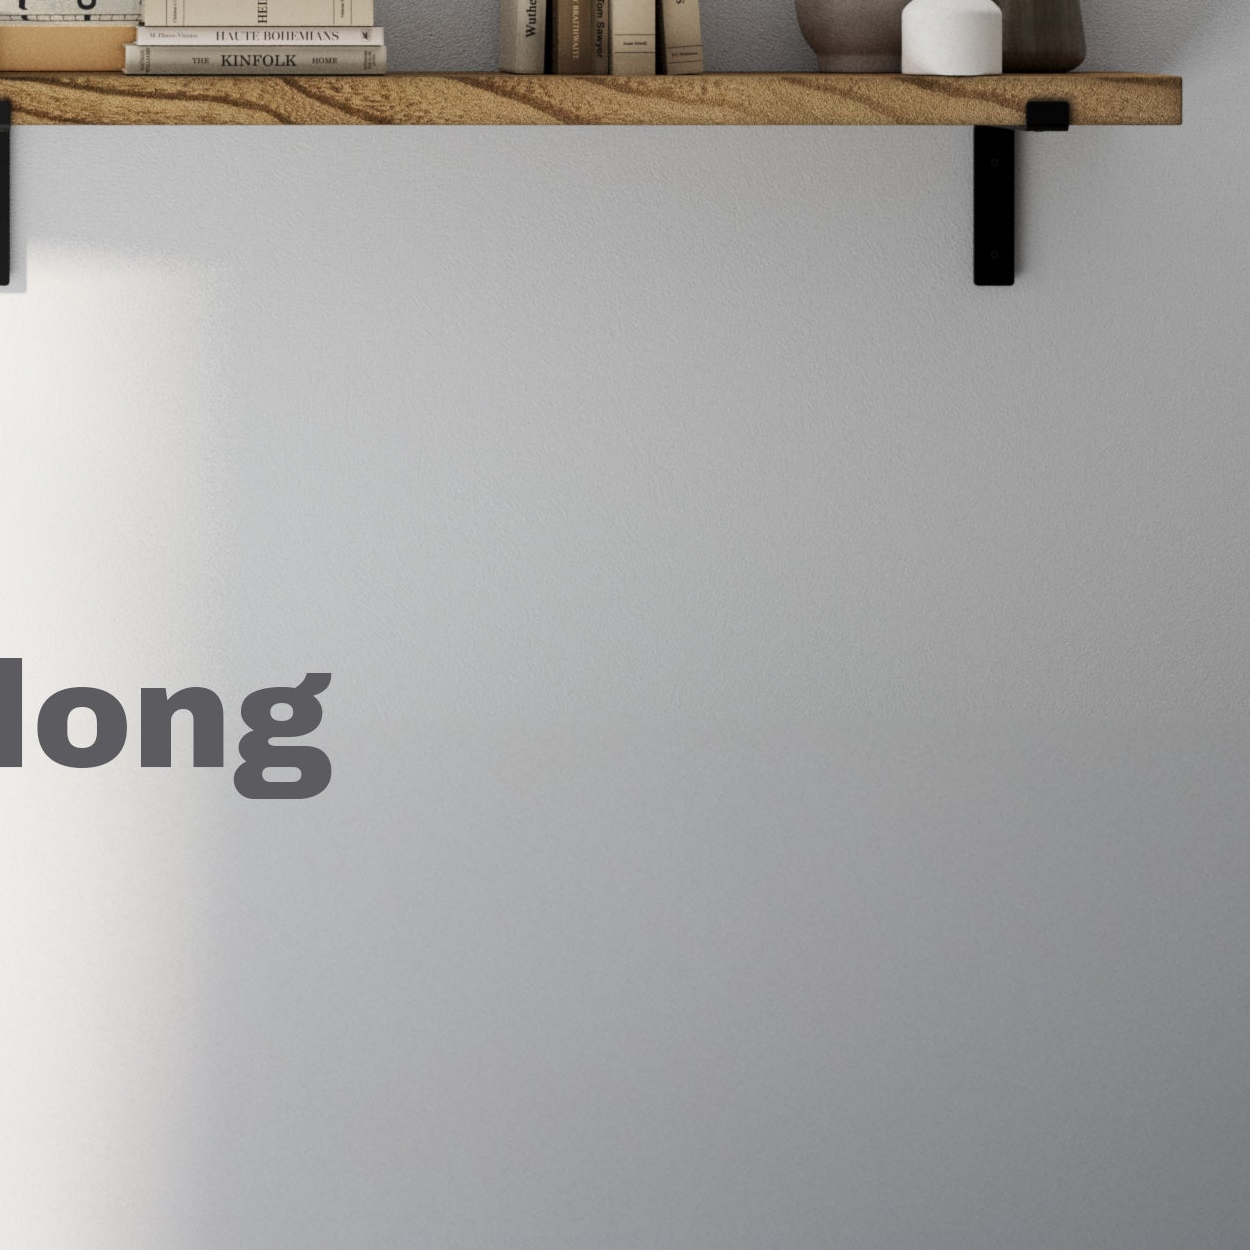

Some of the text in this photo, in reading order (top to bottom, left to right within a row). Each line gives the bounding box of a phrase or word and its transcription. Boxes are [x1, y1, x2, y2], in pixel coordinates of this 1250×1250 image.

[216, 31, 340, 41] HAUTE BOHEMIANS
[595, 22, 605, 59] Sawyer
[221, 54, 297, 67] KINFOLK
